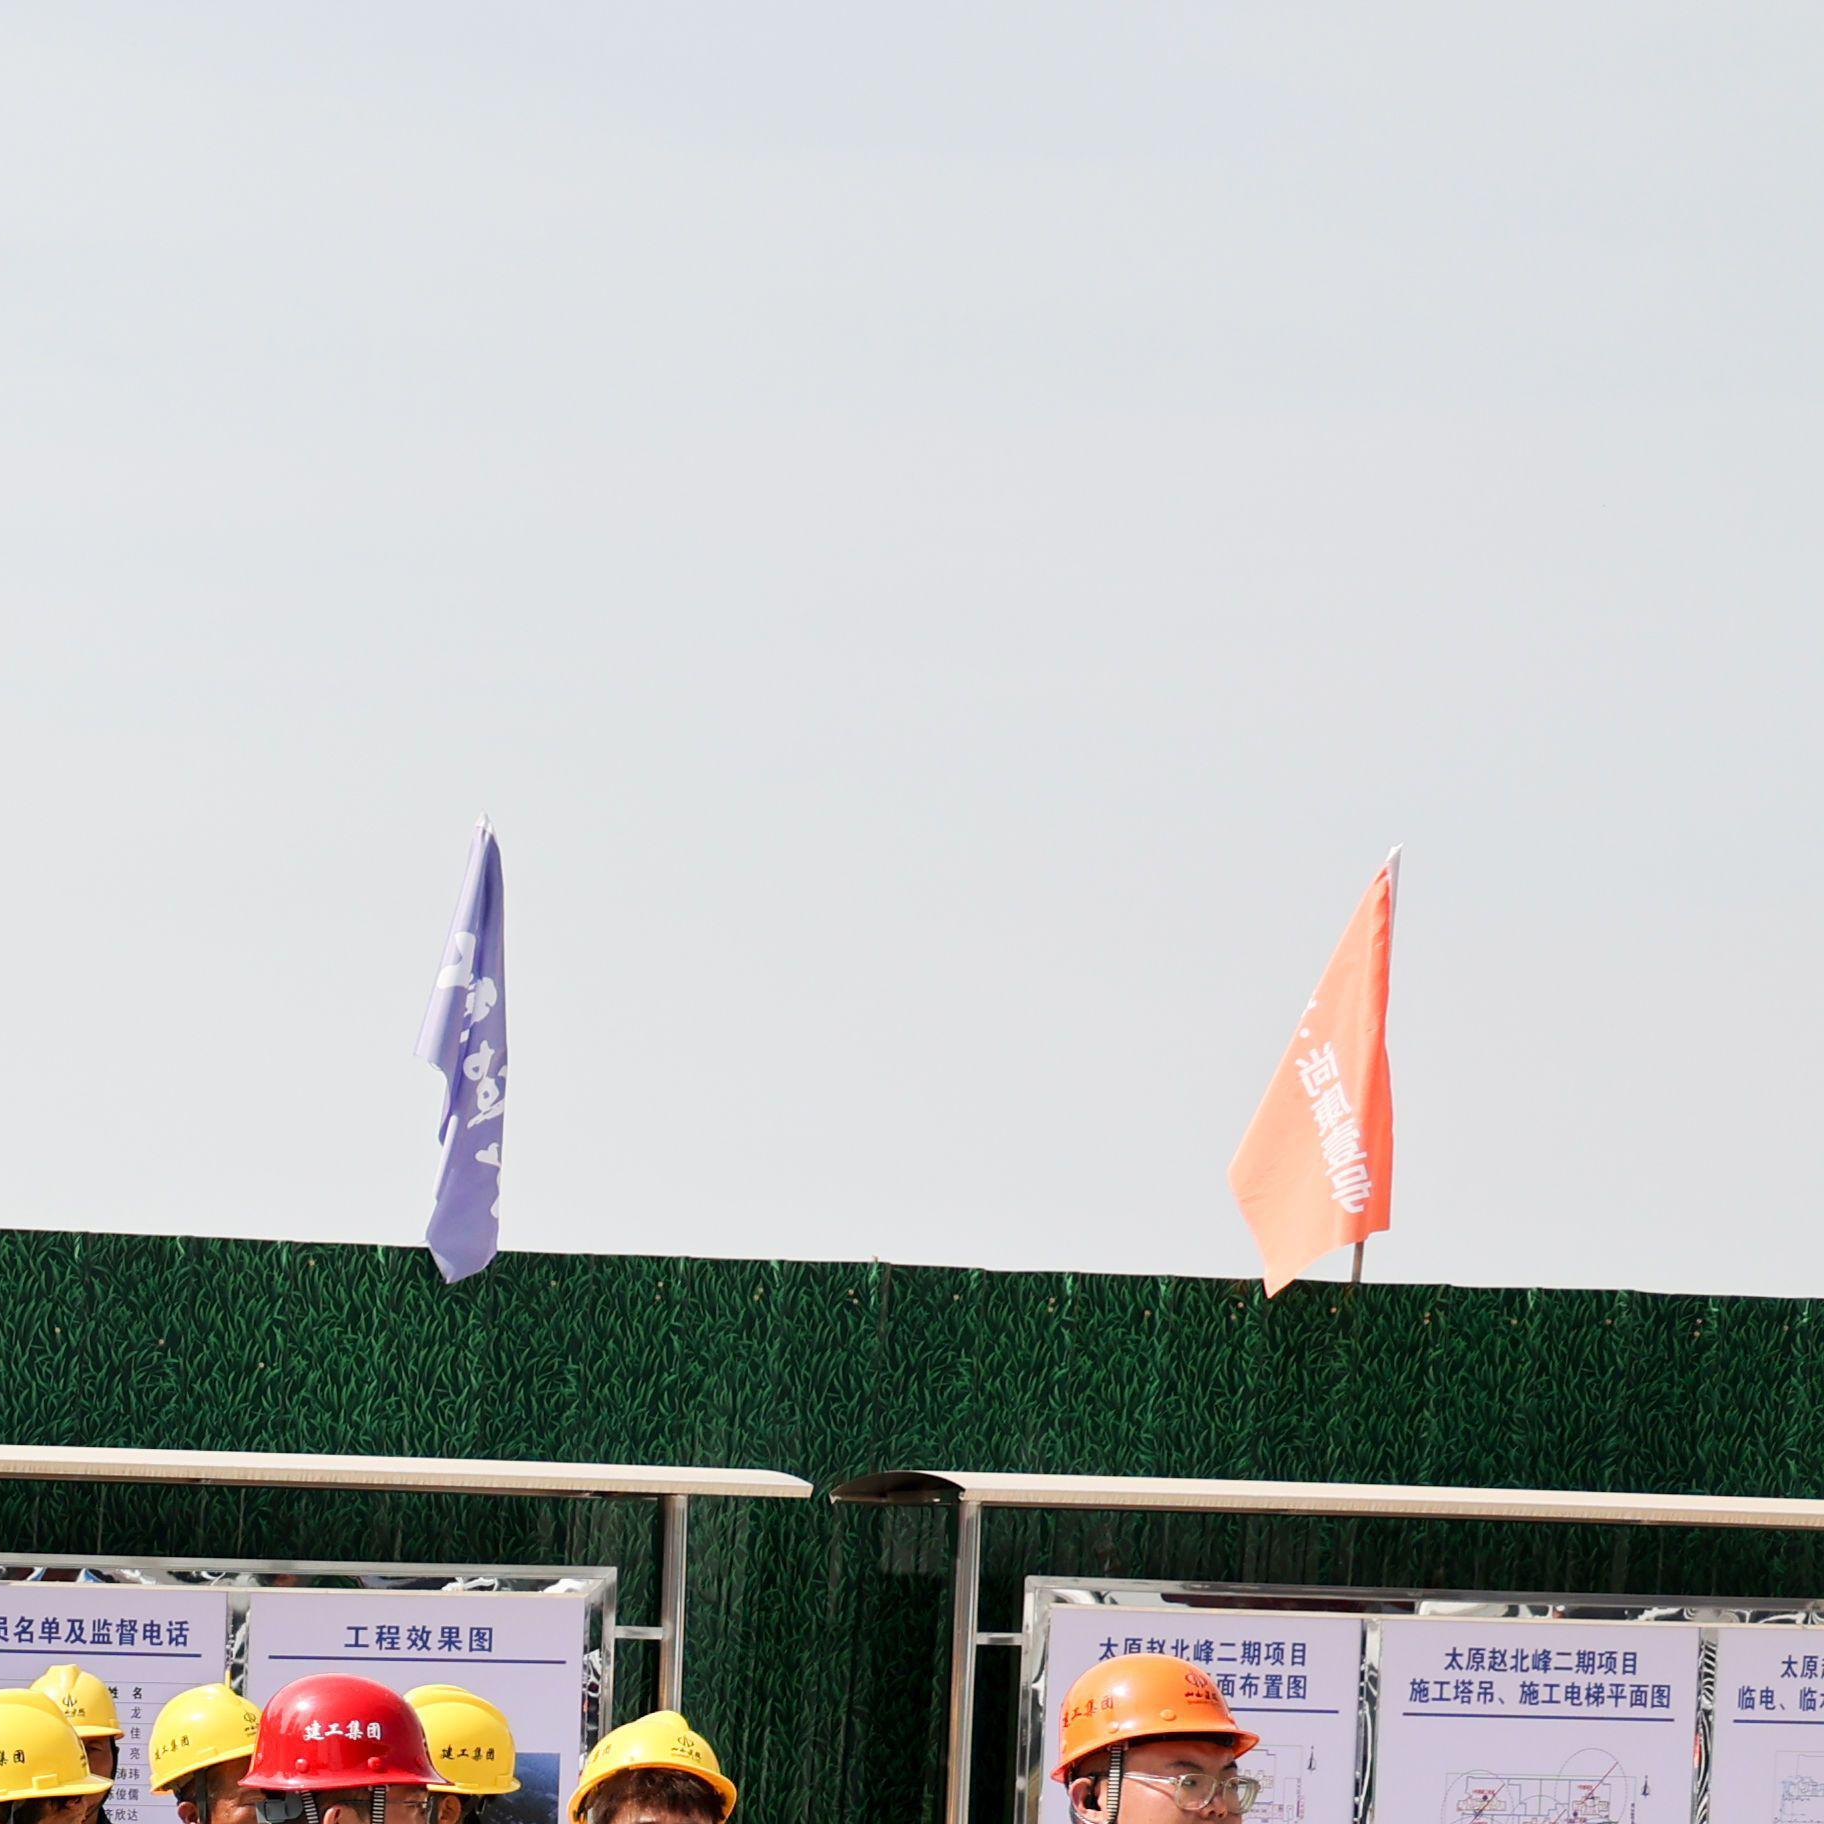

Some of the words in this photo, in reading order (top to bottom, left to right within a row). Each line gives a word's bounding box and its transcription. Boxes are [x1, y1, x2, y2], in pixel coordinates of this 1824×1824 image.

[345, 1625, 495, 1654] 工程效果图
[1098, 1636, 1307, 1667] 太原赵北峰二期项目
[1443, 1646, 1639, 1676] 太原赵北峰二期项目
[132, 1686, 143, 1700] 名
[1409, 1677, 1672, 1711] 施工塔吊、施工电梯平面图
[130, 1706, 142, 1719] 龙
[130, 1727, 141, 1740] 佳
[304, 1719, 382, 1741] 建工集团
[129, 1747, 141, 1760] 亮
[440, 1745, 496, 1762] 建工集团
